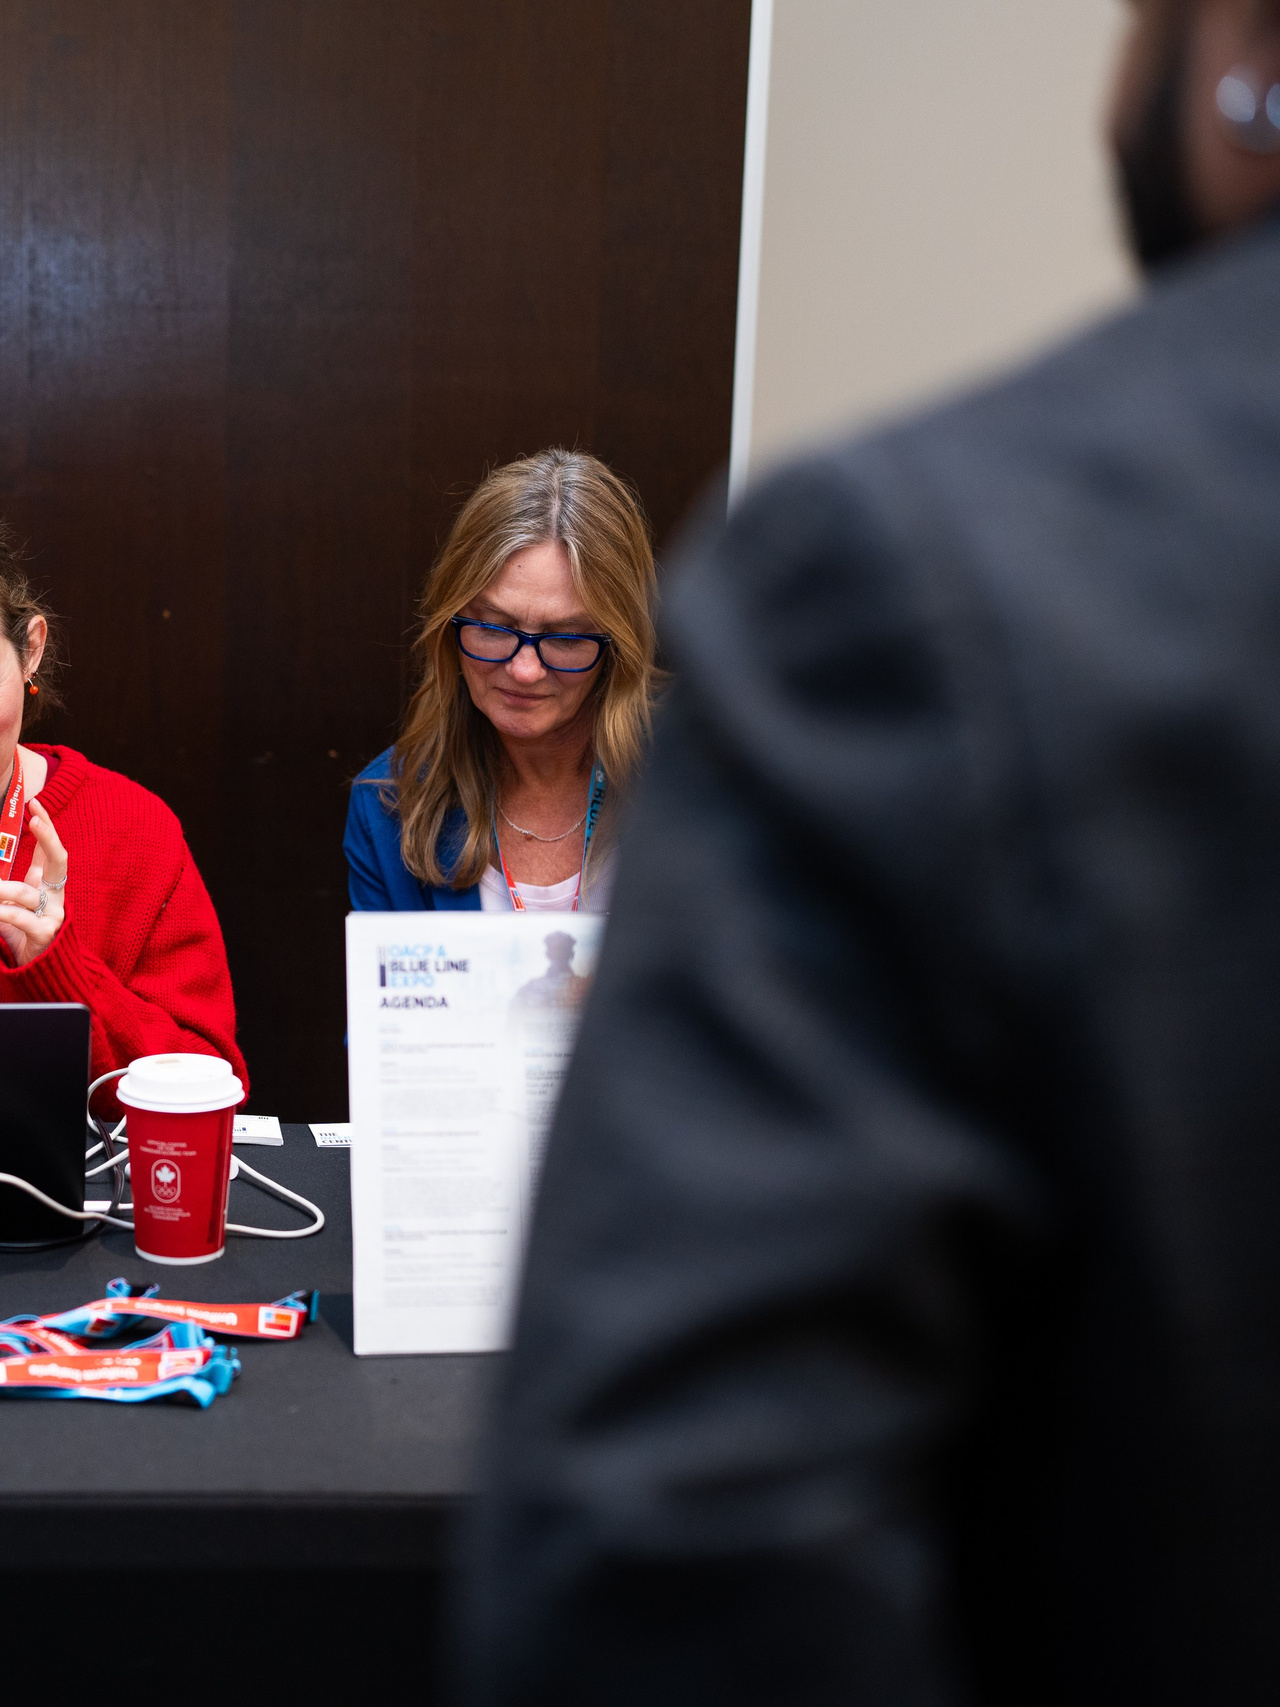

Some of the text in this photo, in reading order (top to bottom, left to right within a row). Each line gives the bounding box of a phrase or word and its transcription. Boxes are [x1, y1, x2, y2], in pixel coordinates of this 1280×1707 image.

[9, 783, 23, 818] Insignia
[389, 945, 433, 958] OACP
[390, 960, 470, 972] BLUE LINE
[390, 974, 435, 987] EXPO
[380, 997, 449, 1009] AGENDA
